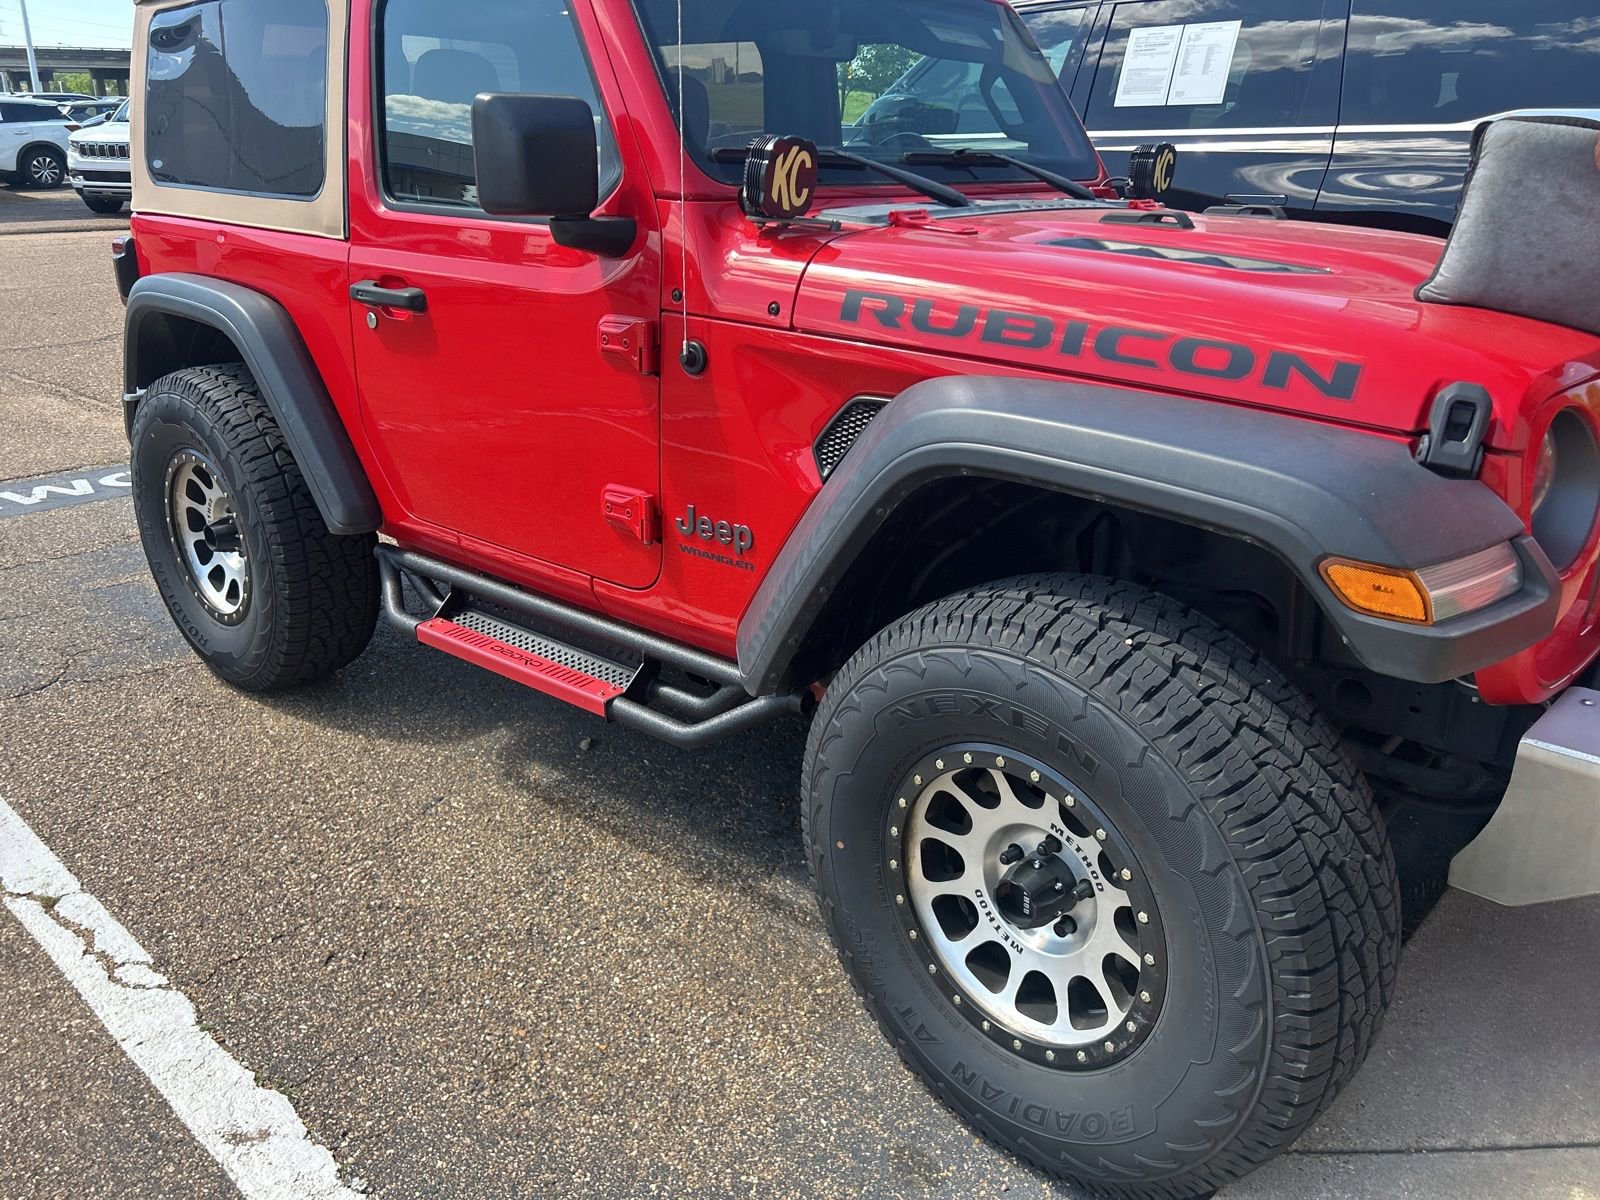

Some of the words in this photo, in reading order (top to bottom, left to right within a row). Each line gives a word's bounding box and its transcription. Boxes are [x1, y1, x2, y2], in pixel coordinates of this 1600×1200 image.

[771, 145, 812, 211] KC
[1153, 148, 1174, 193] KC
[839, 289, 1363, 401] RUBICON
[675, 504, 754, 555] Jeep
[678, 544, 755, 572] WRANGLER
[889, 693, 1100, 776] NEXEN
[1050, 822, 1105, 892] METHOD
[974, 888, 1024, 955] METHOD
[893, 1003, 944, 1045] AT
[950, 1060, 1136, 1140] ROADIAN
